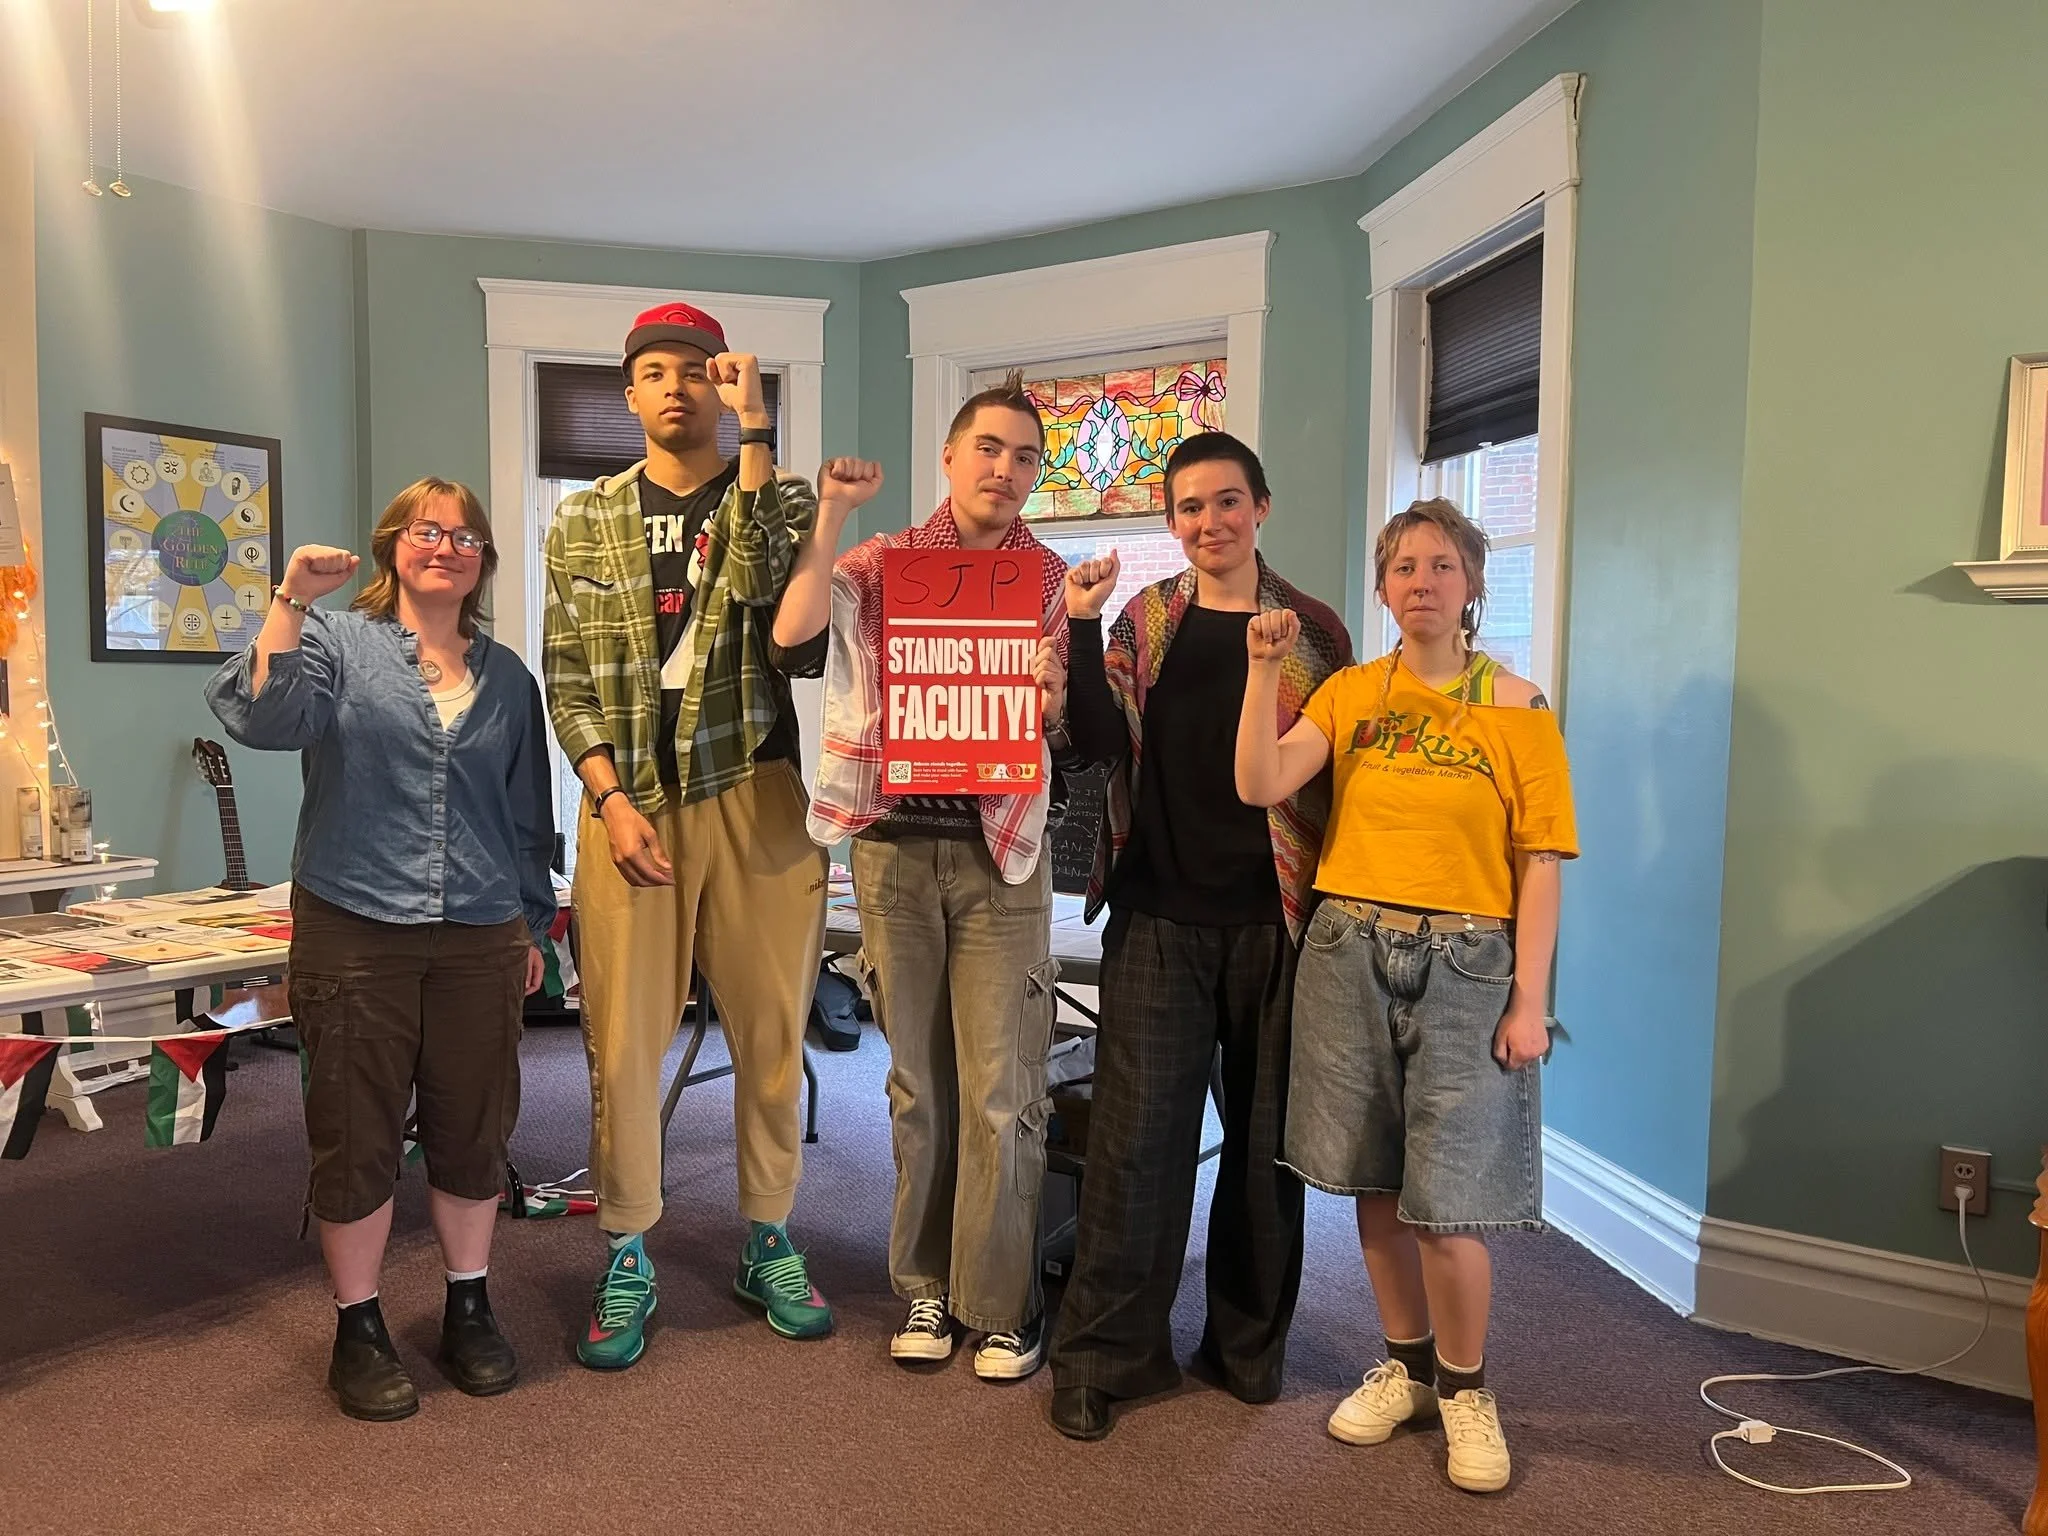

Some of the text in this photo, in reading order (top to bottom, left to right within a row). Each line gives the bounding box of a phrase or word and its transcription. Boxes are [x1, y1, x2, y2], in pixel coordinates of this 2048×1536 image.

[163, 538, 218, 554] GOLDEN
[888, 636, 1037, 675] STANDS WITH
[888, 684, 1037, 741] FACULTY!
